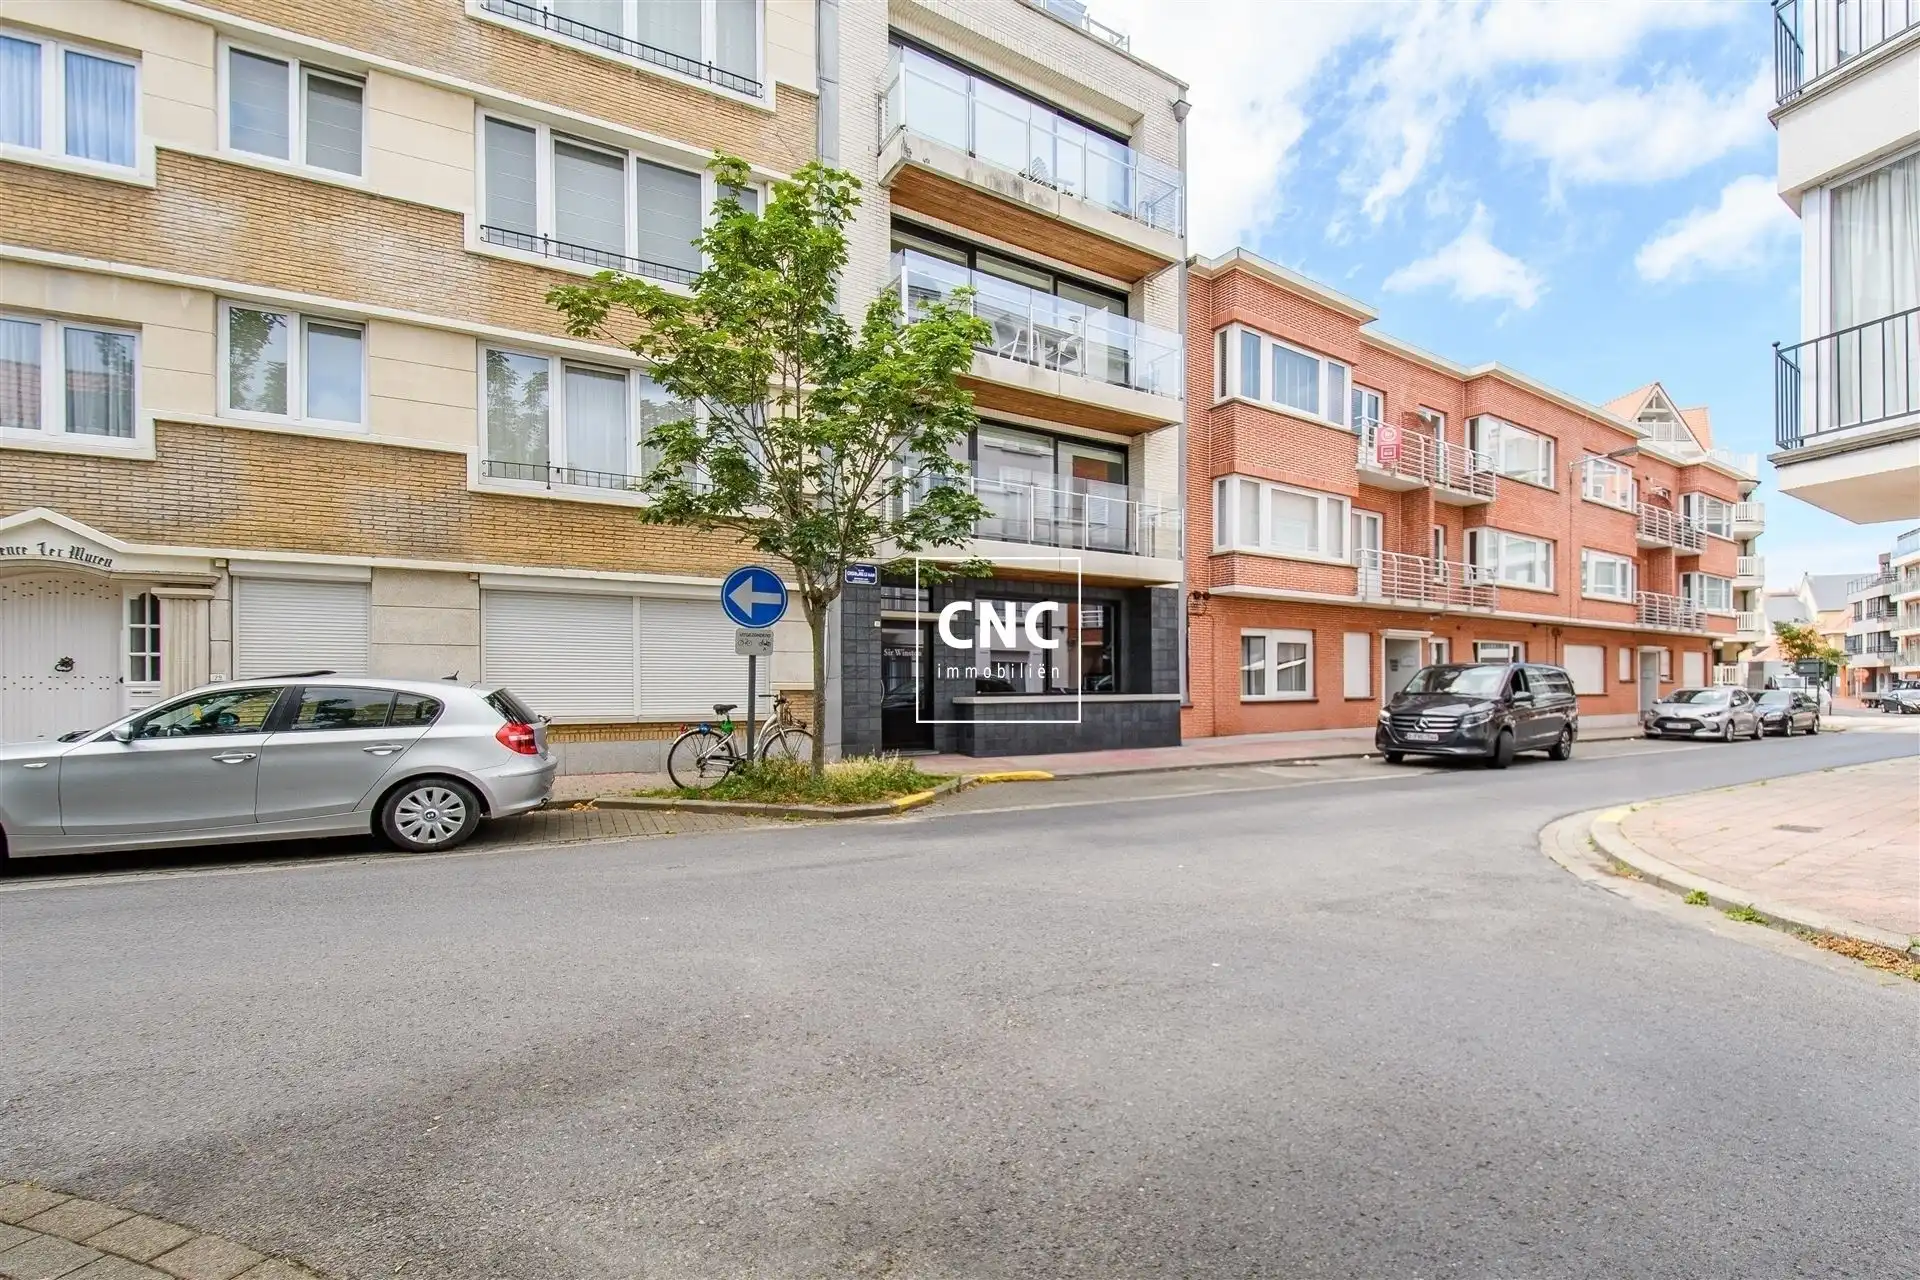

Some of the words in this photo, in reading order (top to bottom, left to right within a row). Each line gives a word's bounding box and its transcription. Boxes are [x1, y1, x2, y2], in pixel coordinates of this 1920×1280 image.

[37, 542, 64, 557] Ter
[69, 545, 113, 567] Muren
[883, 648, 894, 656] Sir
